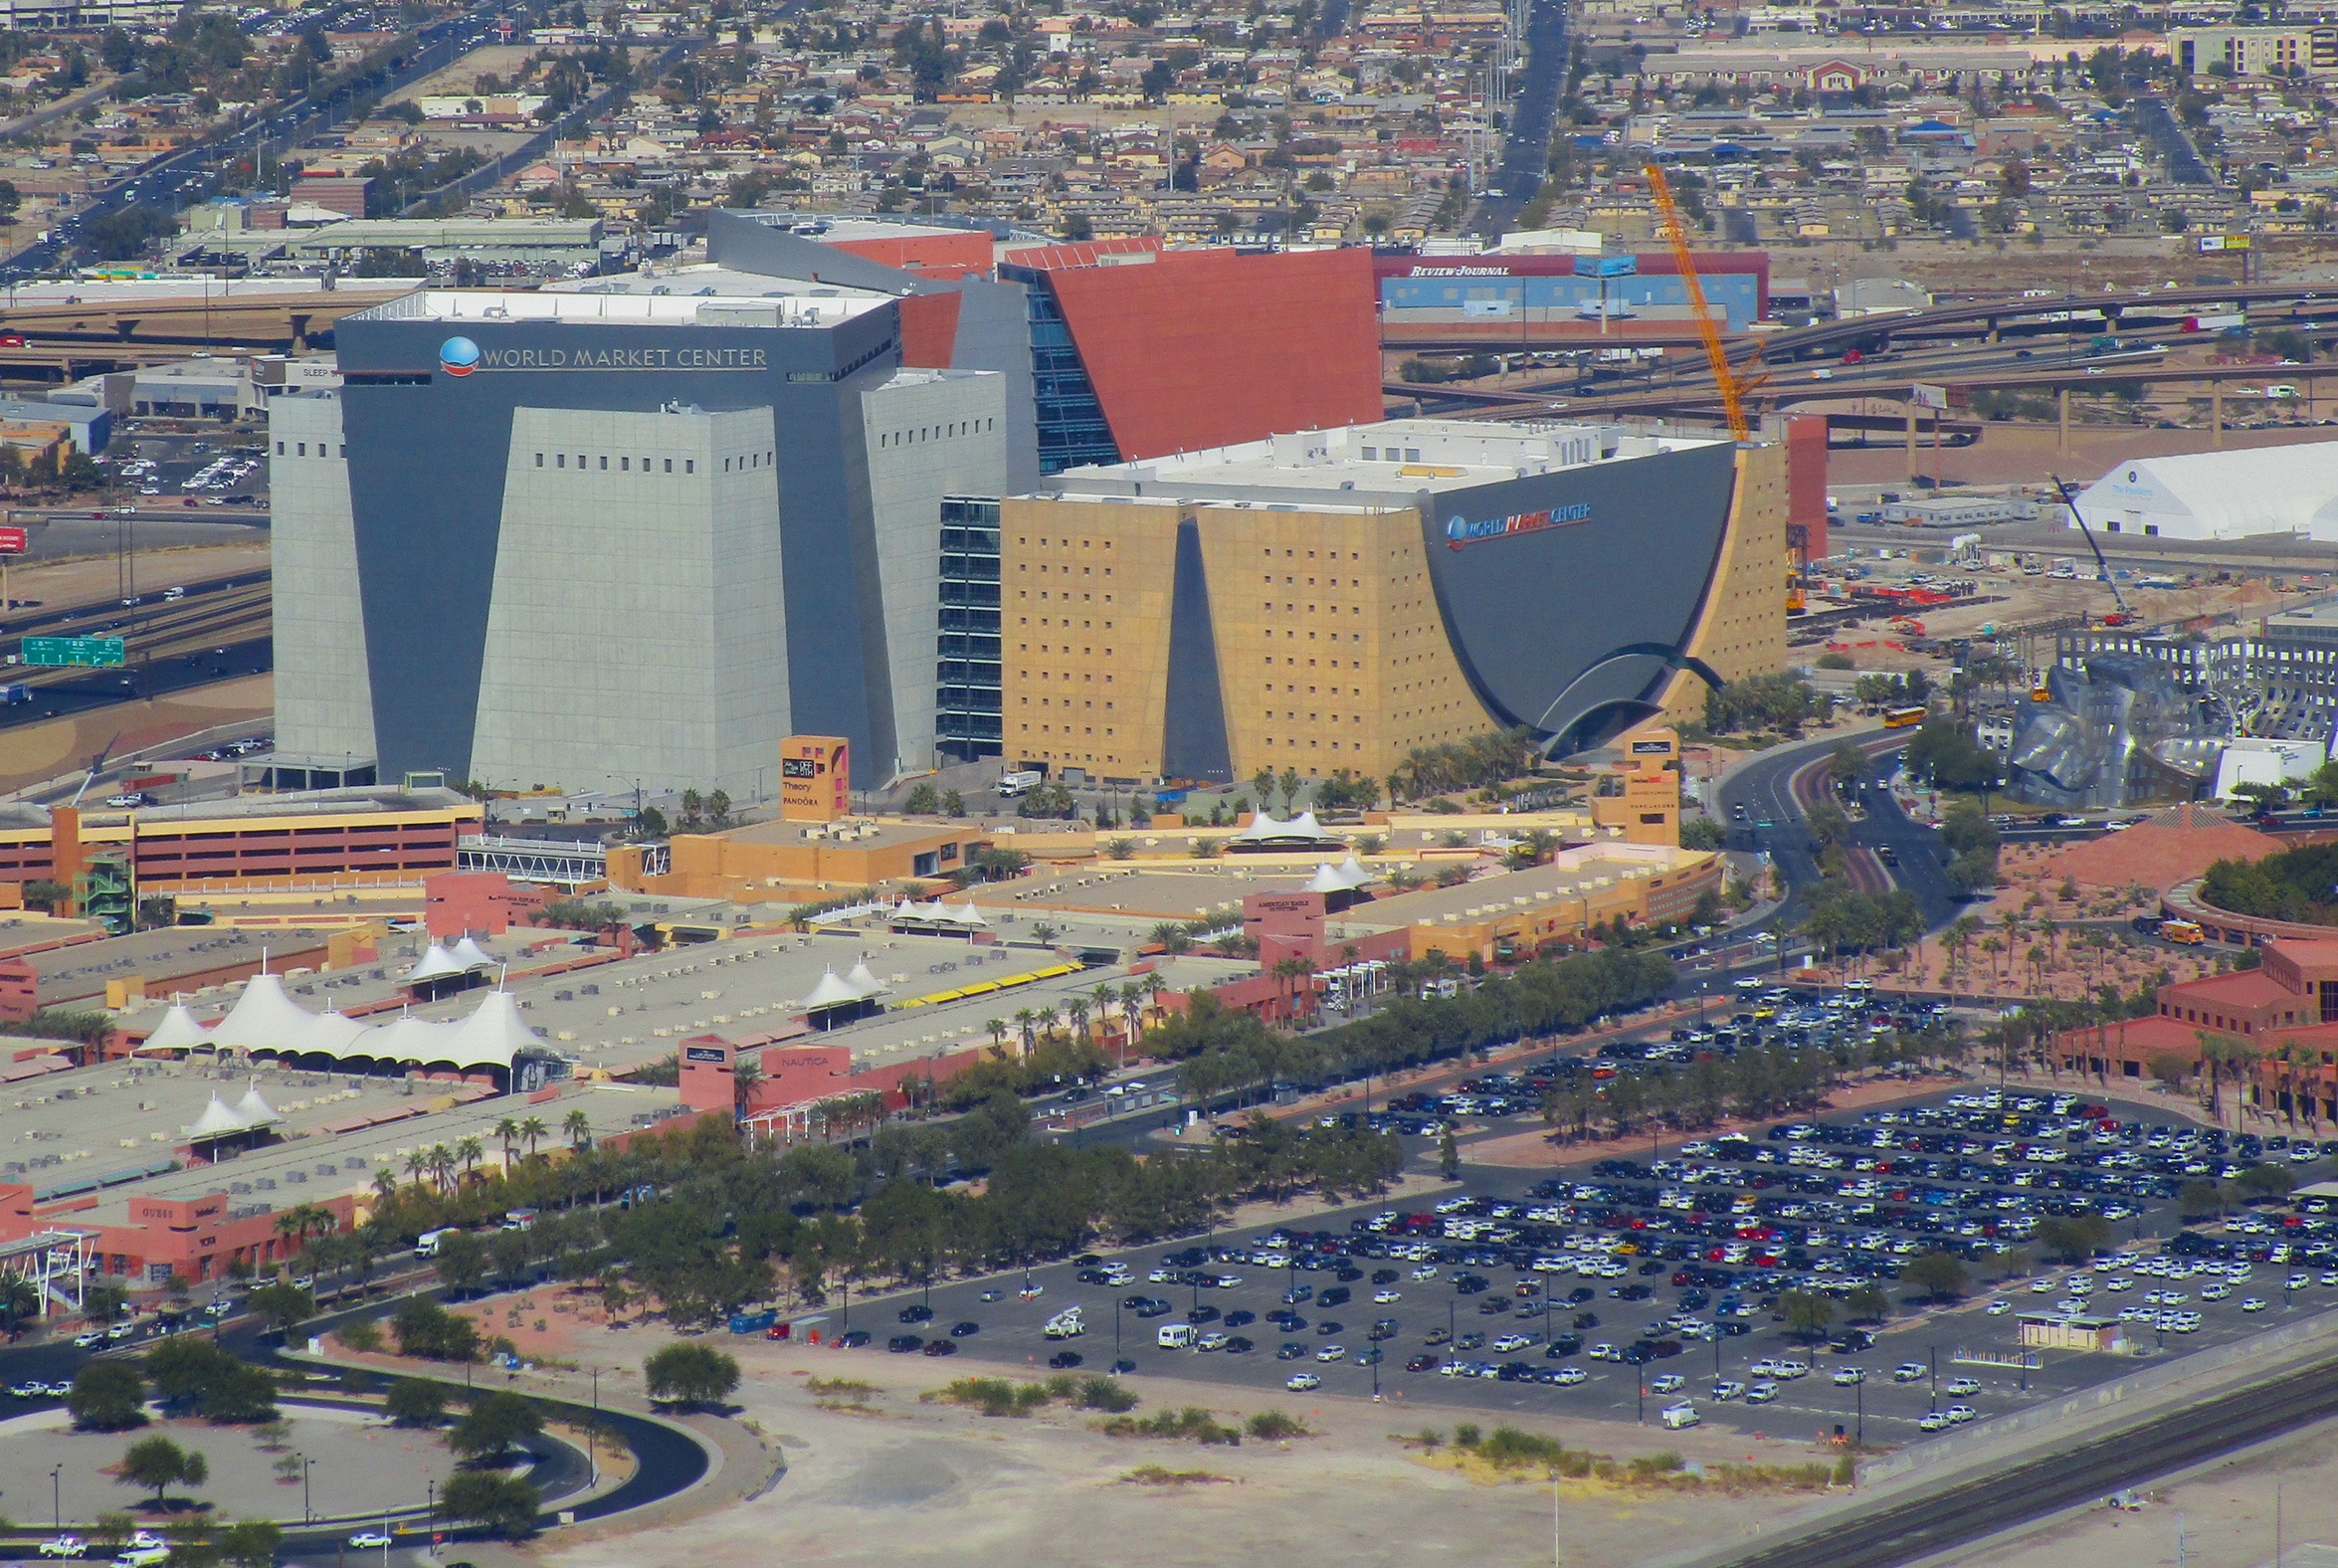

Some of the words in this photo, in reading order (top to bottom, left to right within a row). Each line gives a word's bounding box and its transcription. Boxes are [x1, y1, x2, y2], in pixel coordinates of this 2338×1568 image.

[483, 349, 566, 367] WORLD
[573, 349, 671, 366] MARKET
[677, 348, 767, 366] CENTER
[303, 368, 328, 377] SLEEP
[1467, 519, 1504, 537] WORLD
[1505, 509, 1549, 532] MARKET
[1551, 503, 1591, 523] CENTER
[783, 782, 811, 792] Theory
[782, 1058, 828, 1067] NAUTICA
[142, 1208, 173, 1219] GUESS
